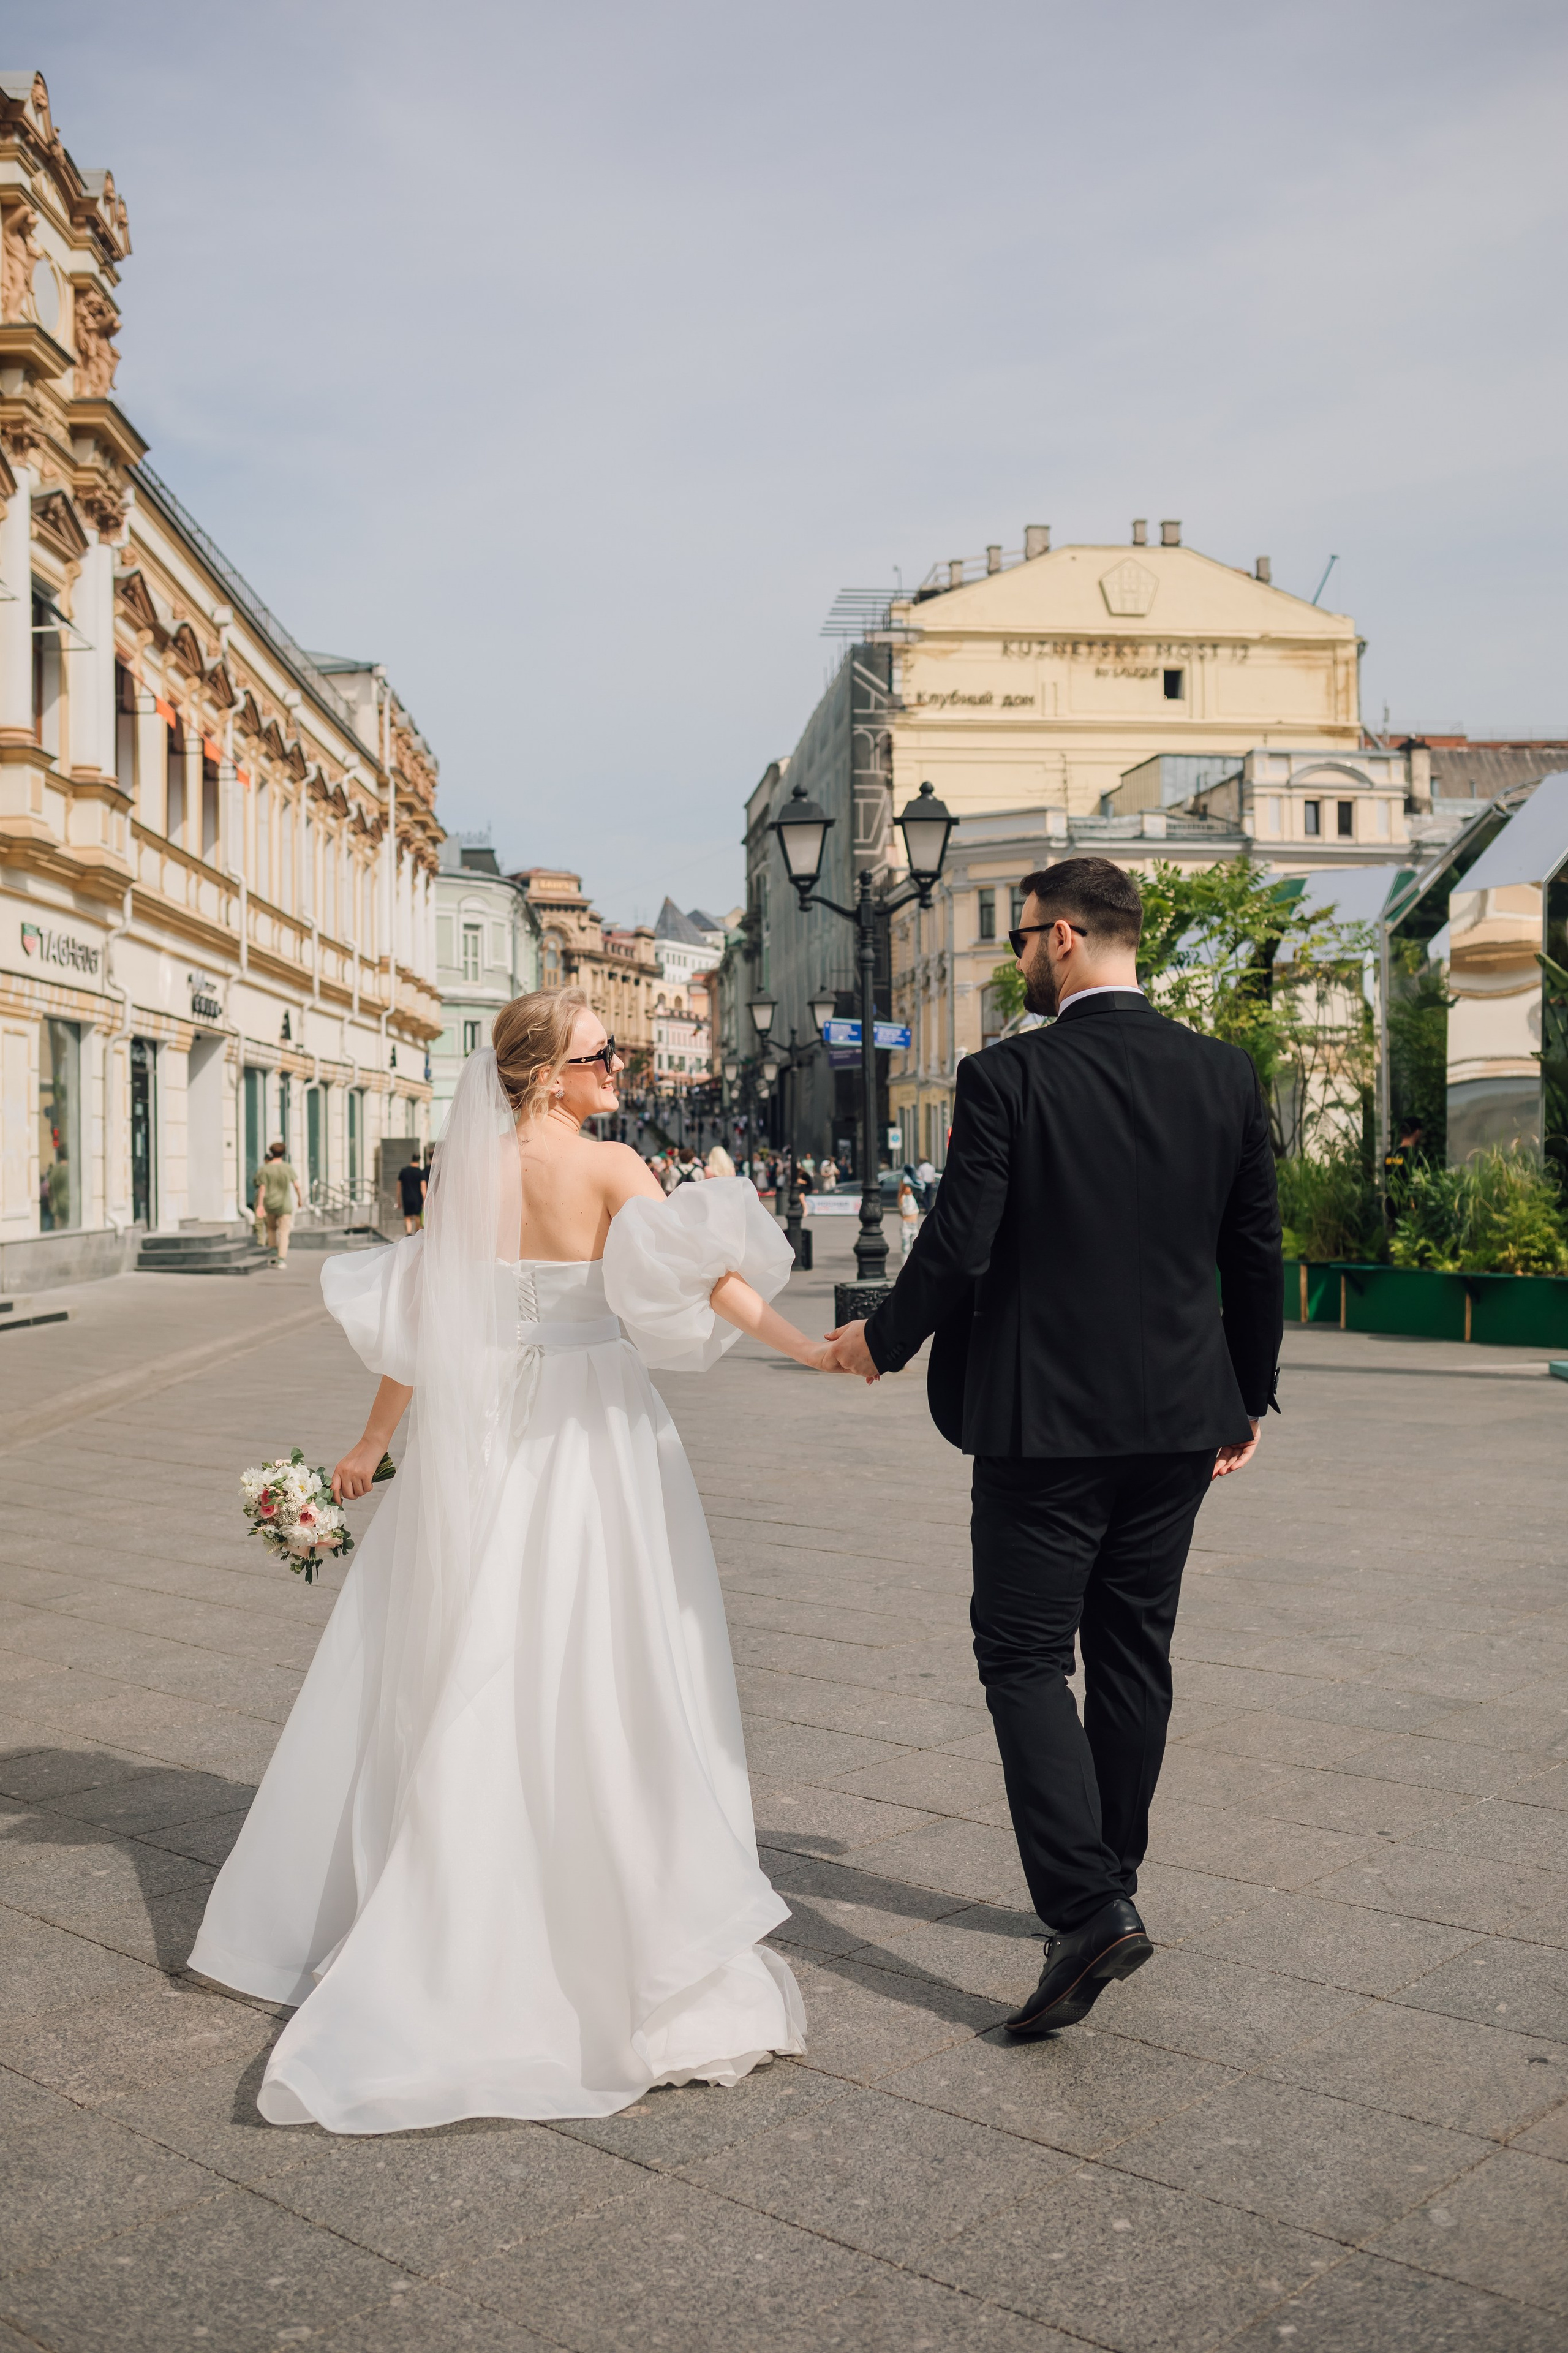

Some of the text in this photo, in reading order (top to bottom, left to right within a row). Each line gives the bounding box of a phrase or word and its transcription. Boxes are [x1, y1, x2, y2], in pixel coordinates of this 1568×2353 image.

[1003, 640, 1251, 665] KUZNETSKY MOST 12
[916, 689, 1035, 711] Клубный дом
